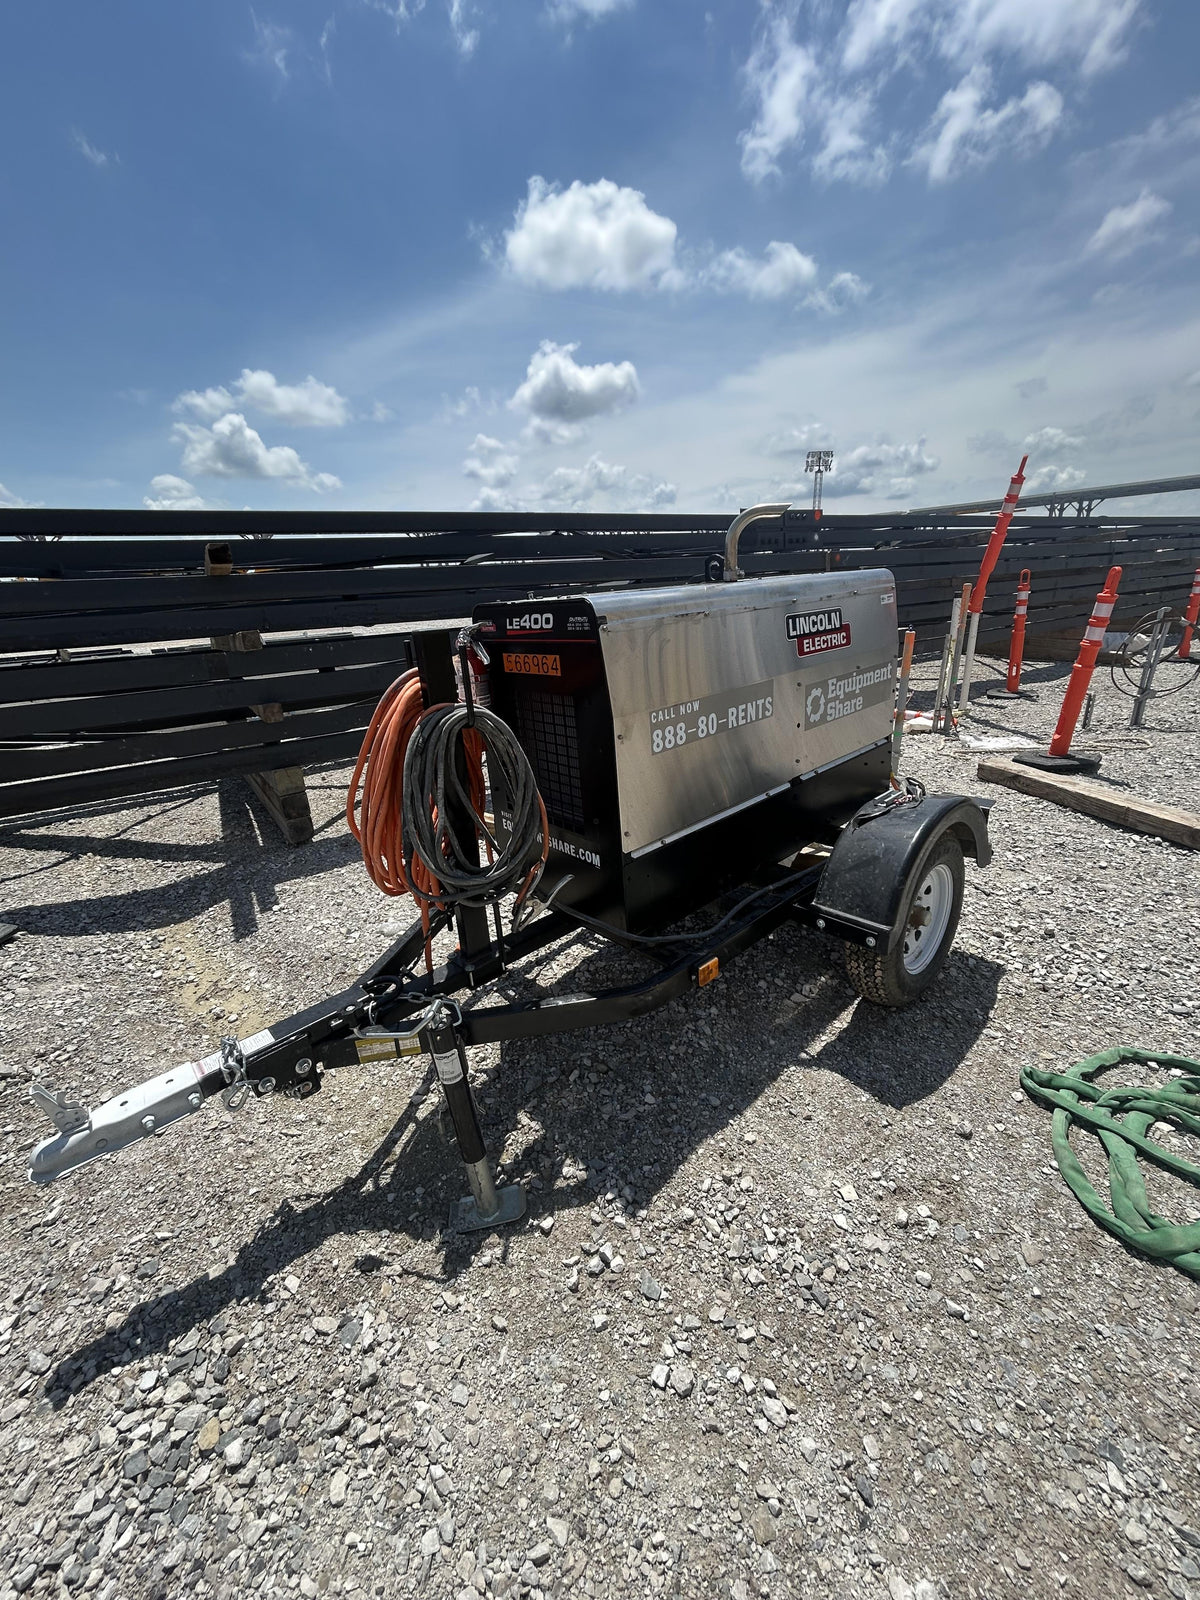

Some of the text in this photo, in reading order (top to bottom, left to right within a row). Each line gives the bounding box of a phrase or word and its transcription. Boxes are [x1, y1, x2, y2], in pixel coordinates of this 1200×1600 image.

[506, 613, 554, 630] LE400
[788, 611, 841, 637] LINCOLN
[803, 631, 847, 653] ELECTRIC
[506, 654, 559, 674] 566964
[827, 662, 893, 699] Equipment
[650, 700, 700, 723] CALL NOW
[826, 695, 864, 722] Share
[652, 696, 773, 753] 888-80-RENTS
